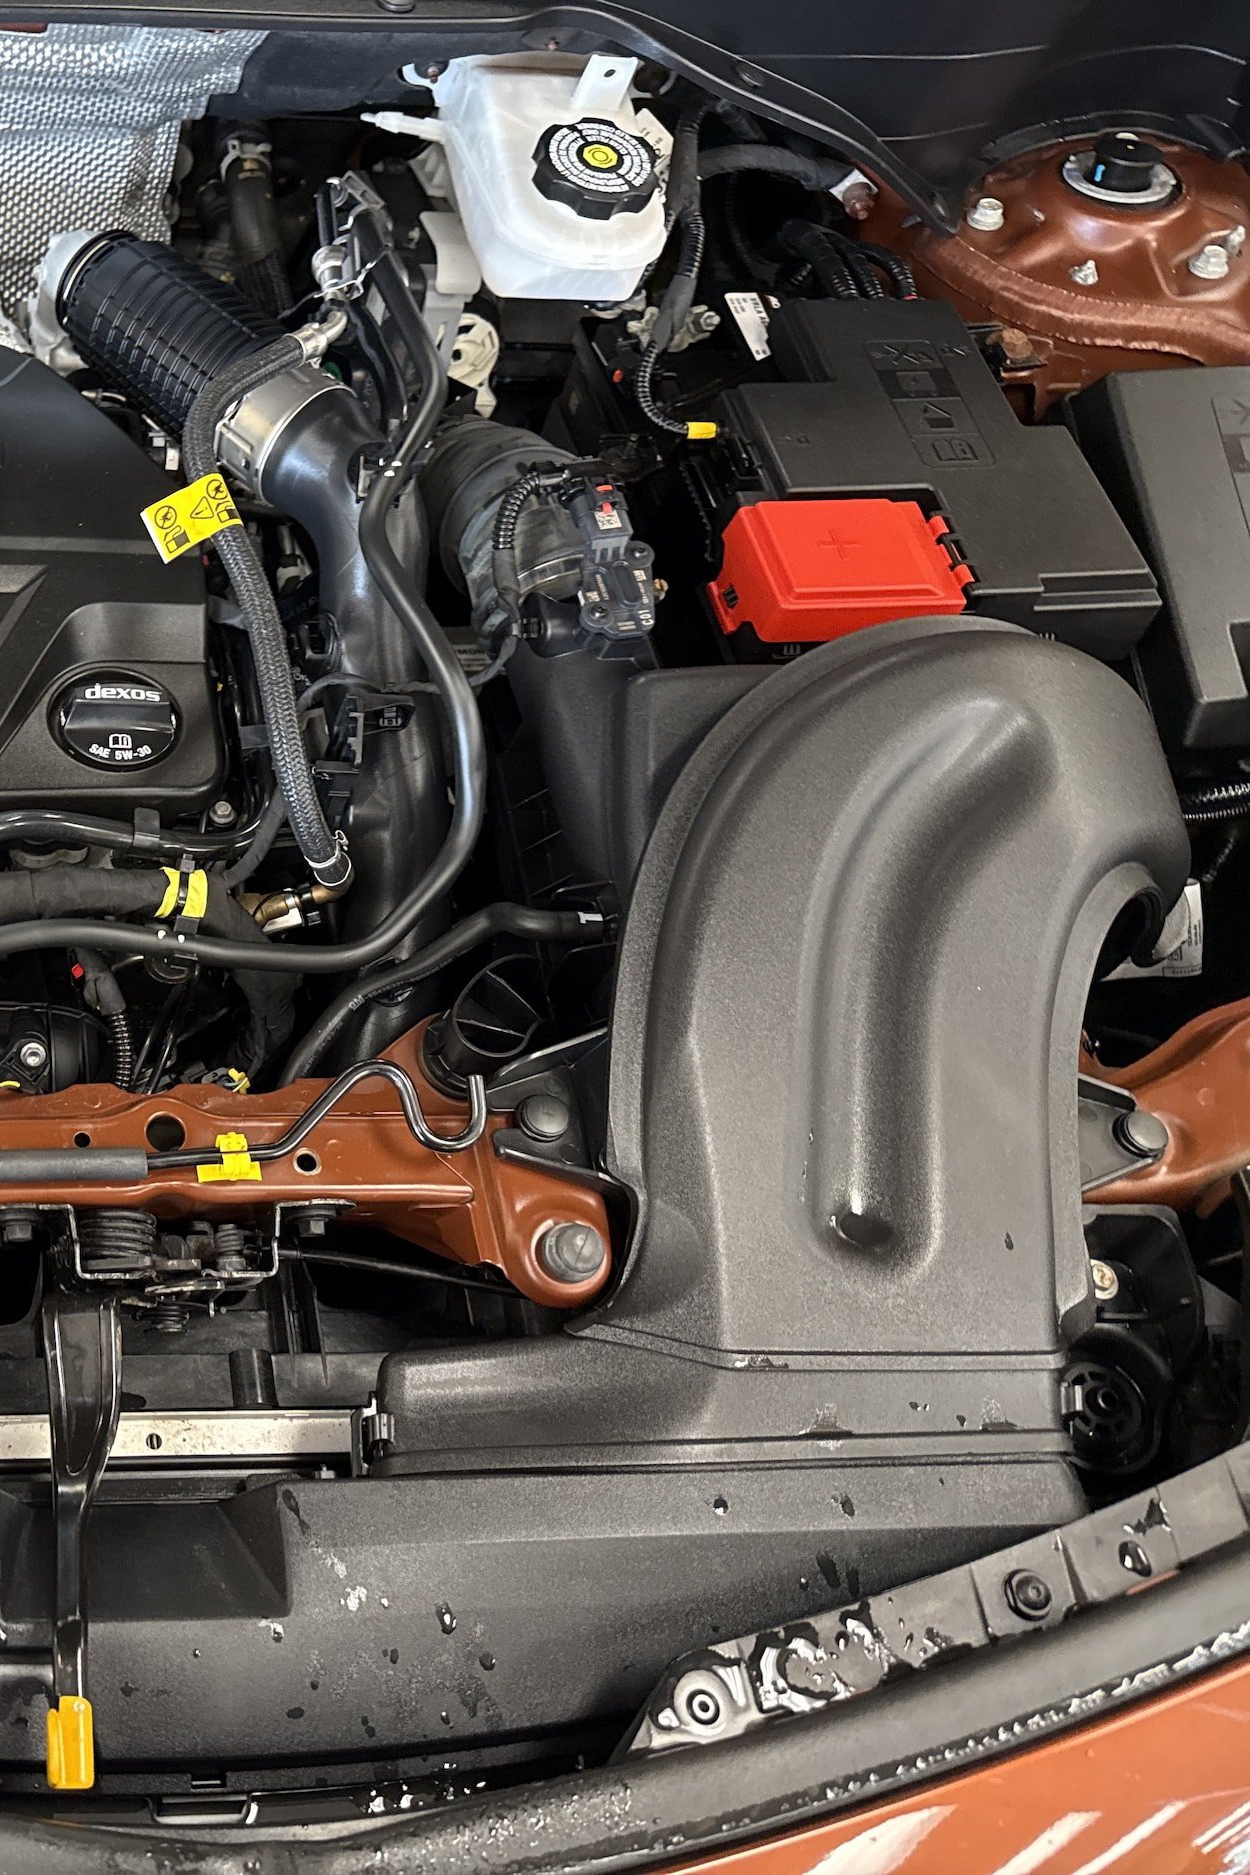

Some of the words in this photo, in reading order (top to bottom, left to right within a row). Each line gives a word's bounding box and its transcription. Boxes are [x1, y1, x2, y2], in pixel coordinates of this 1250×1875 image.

[85, 683, 161, 702] dexos
[88, 743, 110, 759] SAE
[114, 744, 152, 761] 5W-30
